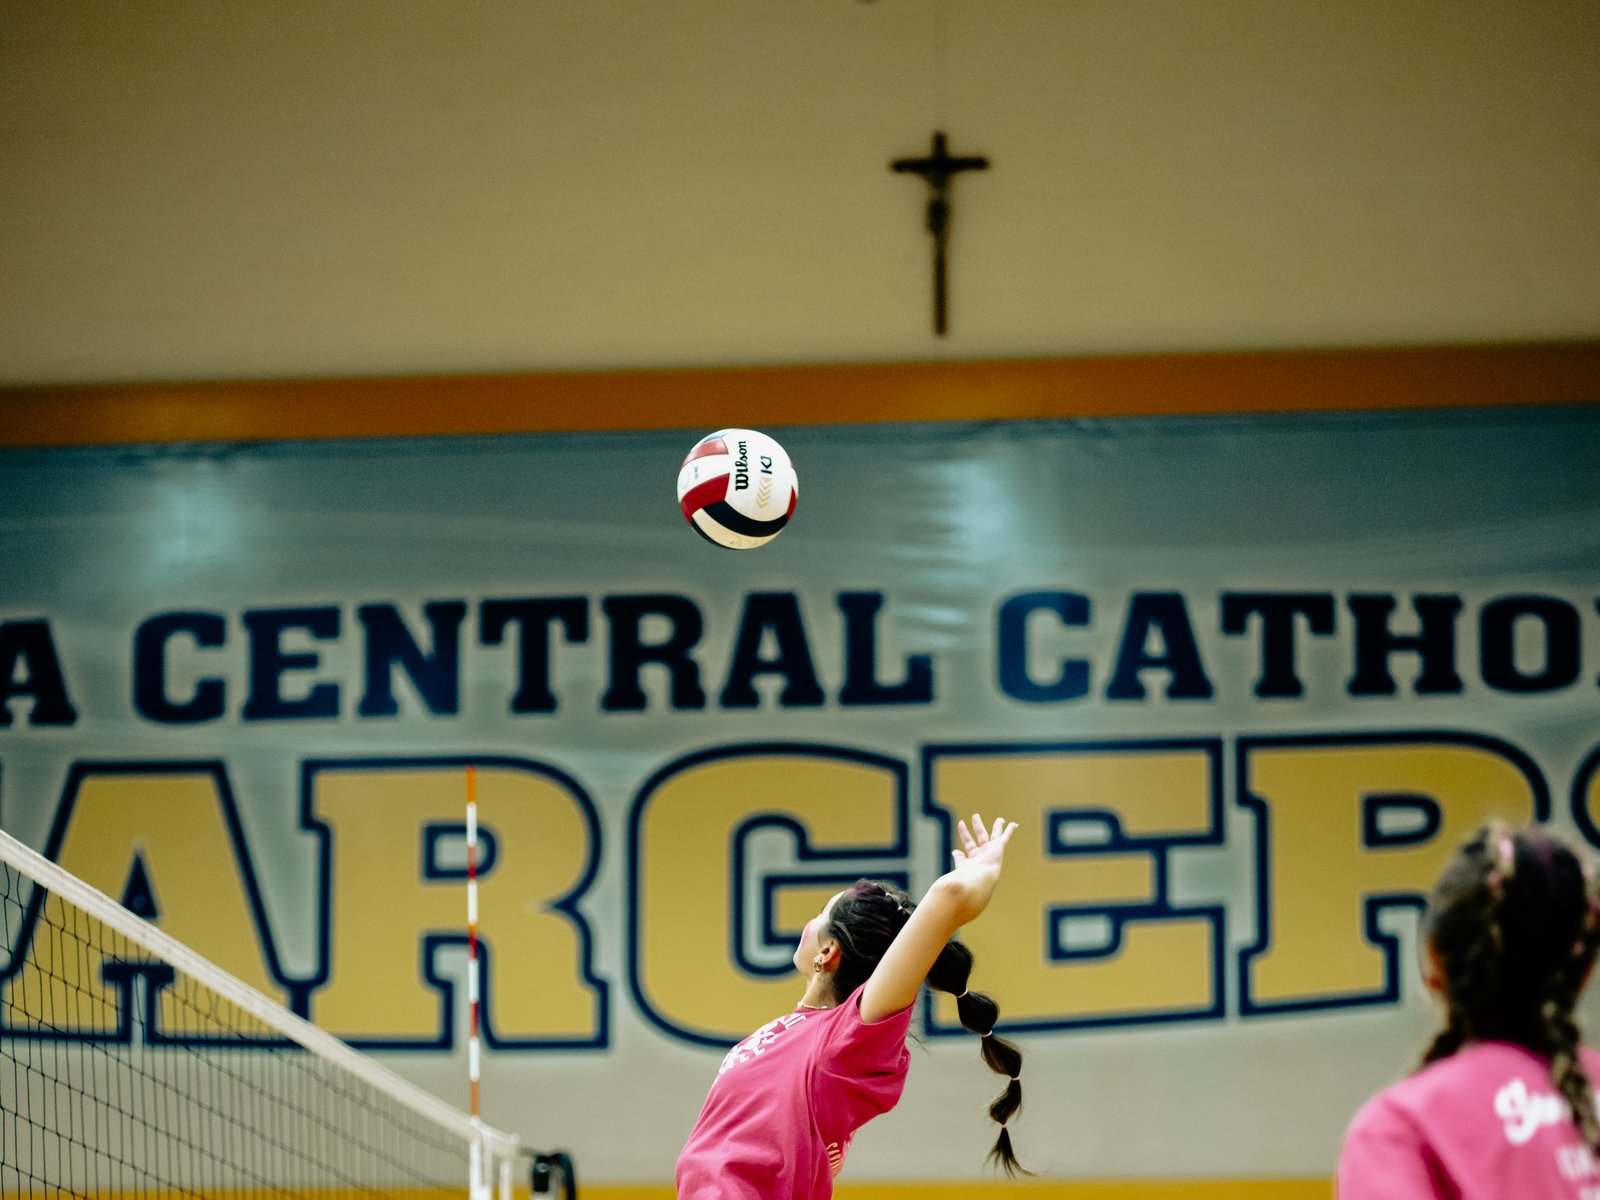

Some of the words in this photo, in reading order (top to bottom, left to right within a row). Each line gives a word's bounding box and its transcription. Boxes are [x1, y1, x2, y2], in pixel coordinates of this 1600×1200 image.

[734, 440, 750, 492] Wilson
[132, 591, 934, 725] CENTRAL
[996, 590, 1600, 702] CATHO
[0, 728, 1600, 1051] ARGER
